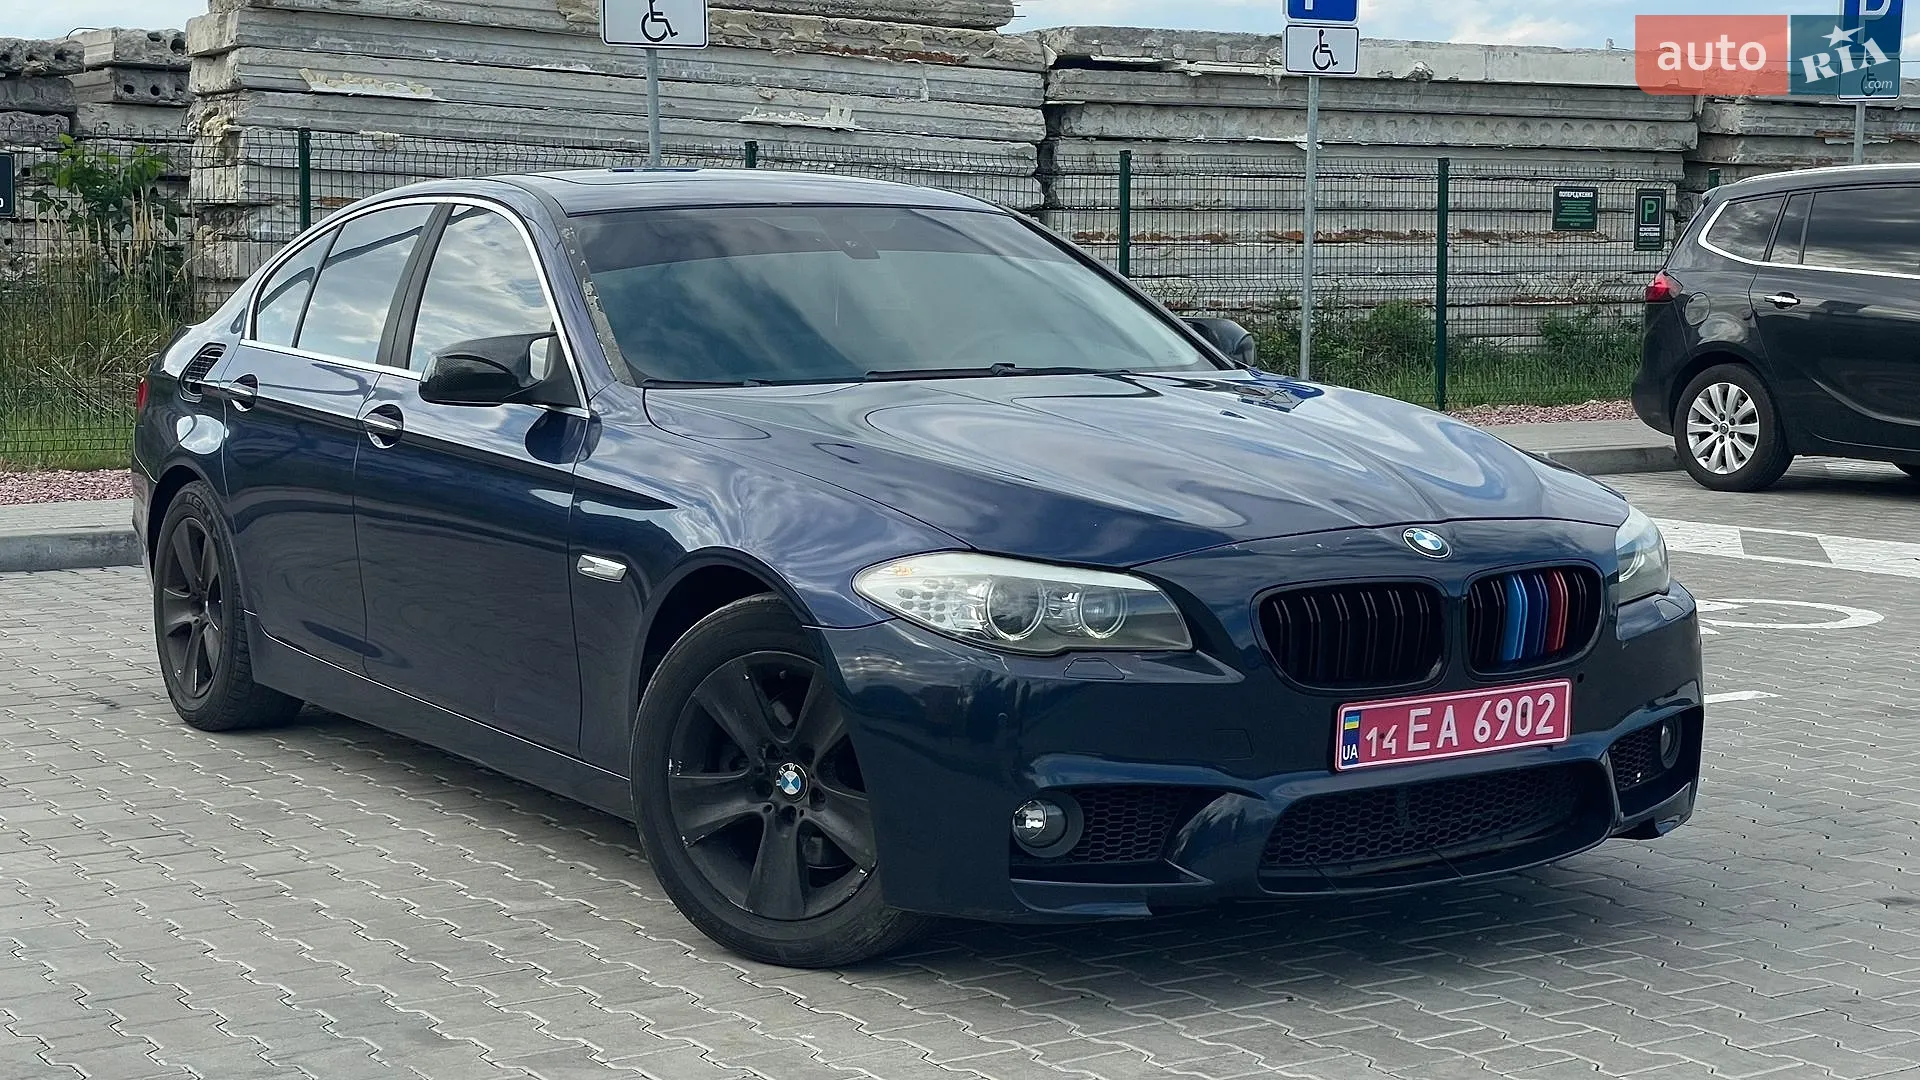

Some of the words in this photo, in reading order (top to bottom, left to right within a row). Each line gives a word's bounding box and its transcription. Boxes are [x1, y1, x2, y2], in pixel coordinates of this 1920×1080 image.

[1644, 200, 1657, 222] P
[1365, 725, 1399, 757] 14
[1407, 705, 1459, 752] EA
[1473, 693, 1556, 743] 6902
[1342, 744, 1359, 761] UA
